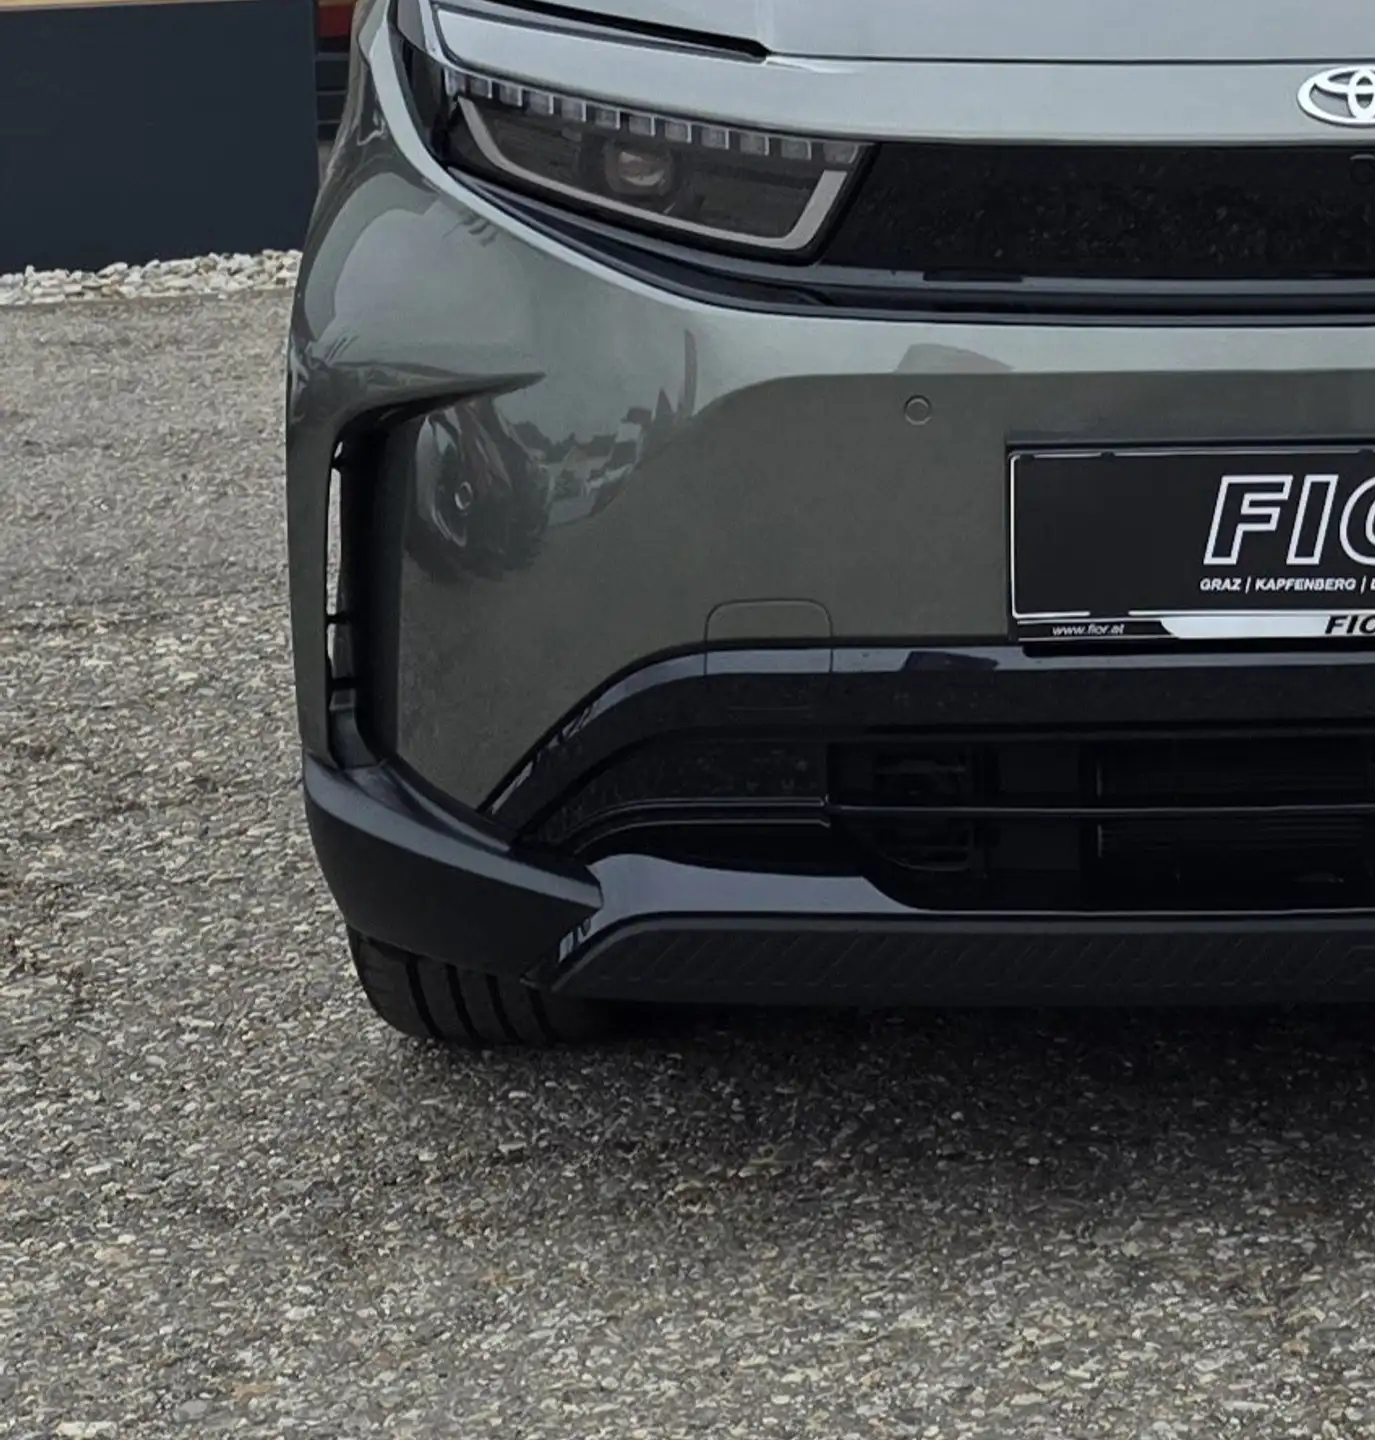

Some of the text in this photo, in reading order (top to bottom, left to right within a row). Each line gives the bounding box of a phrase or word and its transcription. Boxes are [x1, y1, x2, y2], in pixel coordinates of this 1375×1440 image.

[1200, 577, 1241, 592] GRAZ
[1255, 577, 1356, 591] KAPFENBERG
[1052, 623, 1125, 636] www.fior.at
